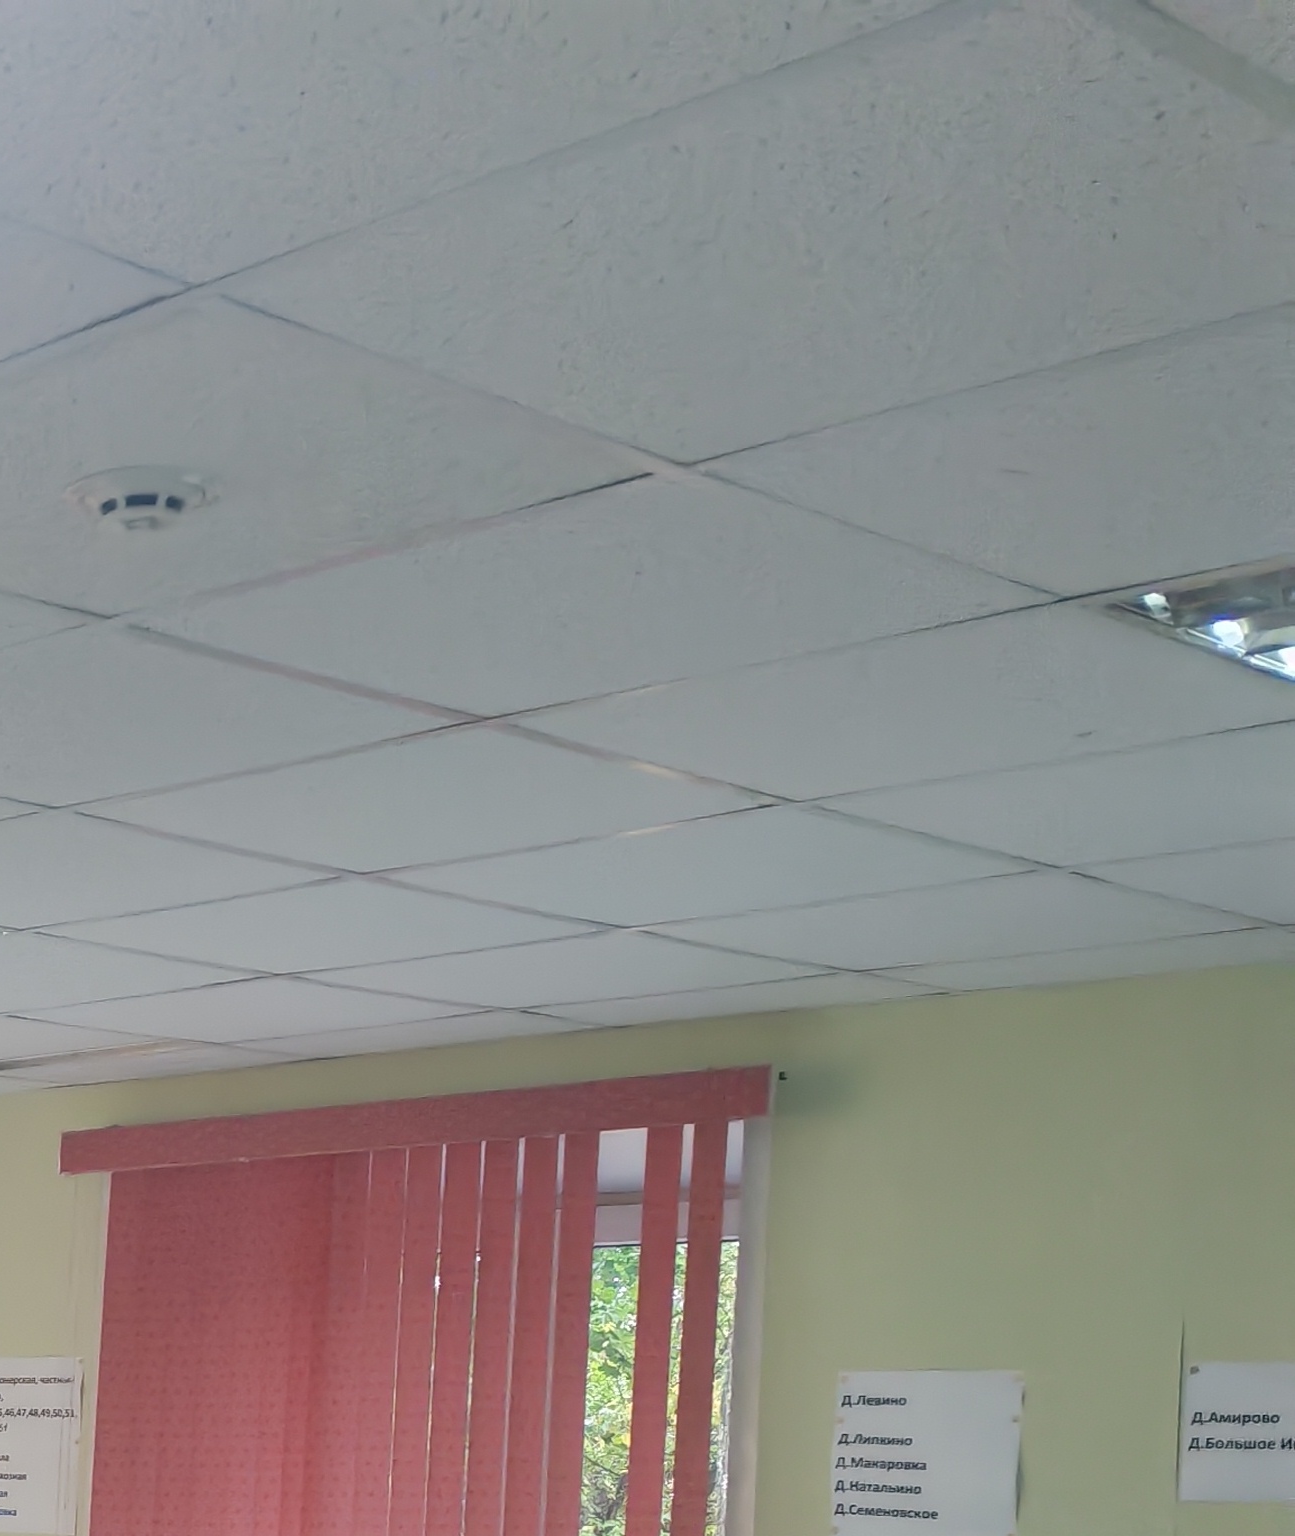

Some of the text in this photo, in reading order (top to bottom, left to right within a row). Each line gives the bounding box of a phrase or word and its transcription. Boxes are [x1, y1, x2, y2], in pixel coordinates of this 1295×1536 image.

[1191, 1411, 1280, 1426] Д.Амирово
[1188, 1437, 1276, 1452] Д.Большое
[835, 1457, 927, 1472] Д.Макаровка
[834, 1480, 922, 1494] Д.Натальино
[834, 1503, 939, 1519] Д.Семеновское
